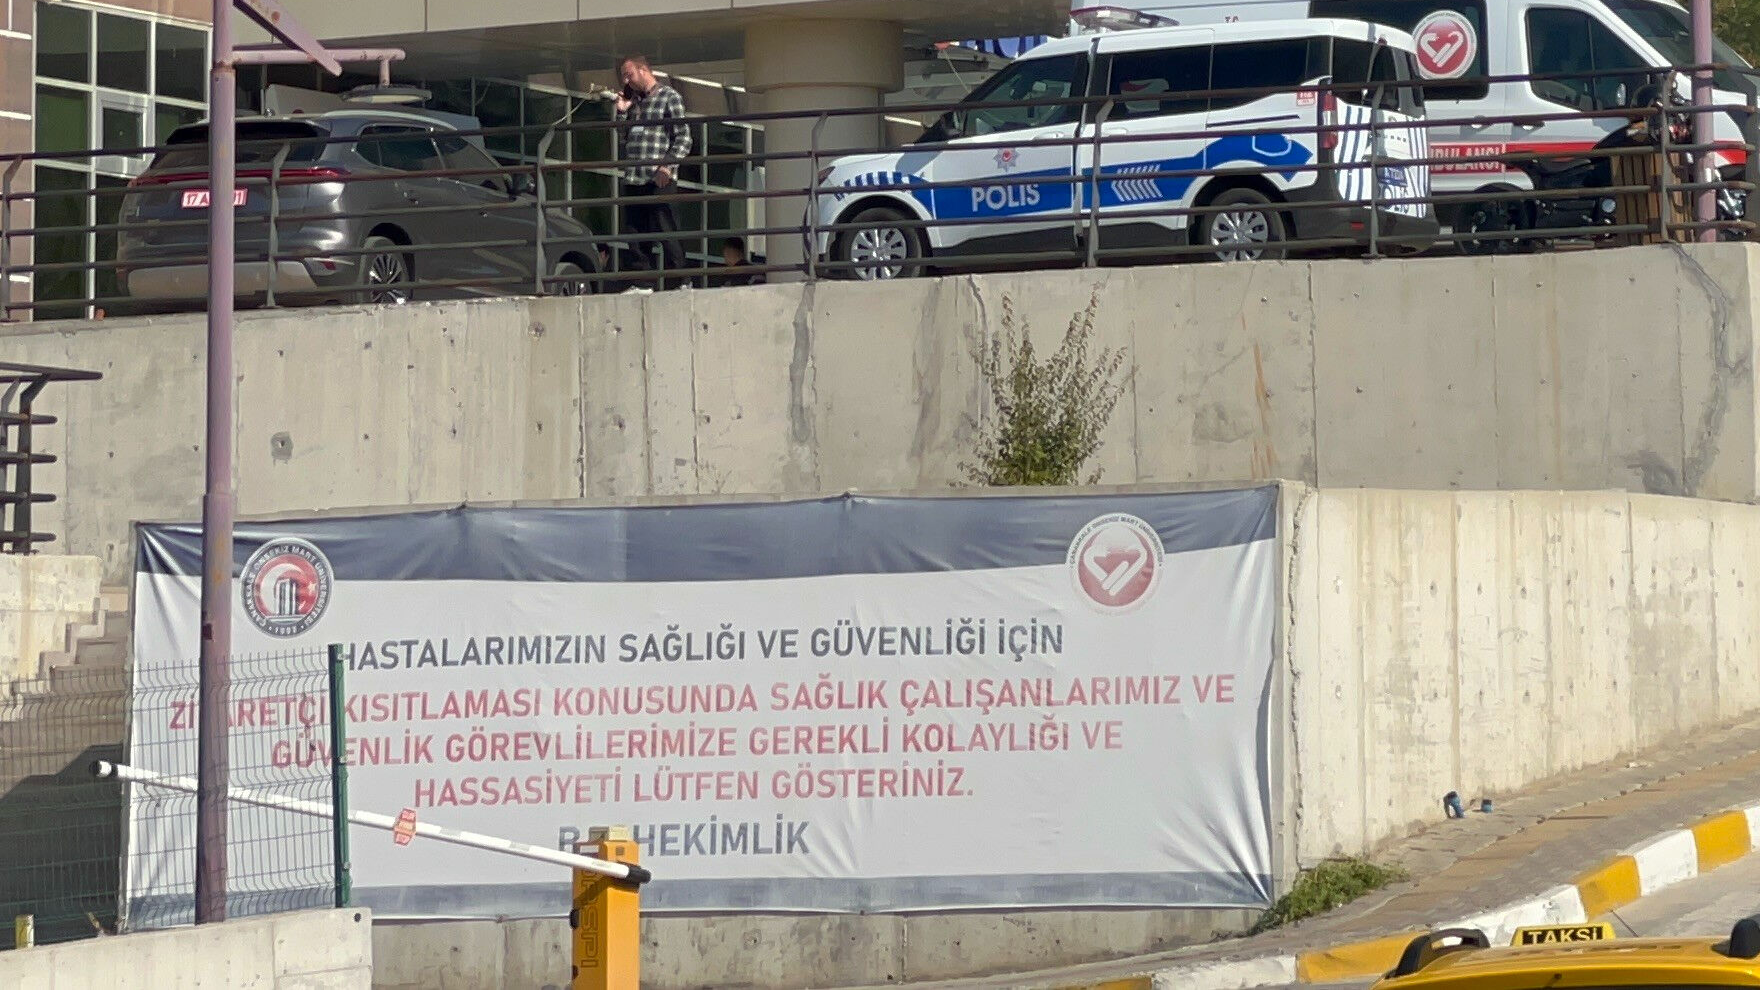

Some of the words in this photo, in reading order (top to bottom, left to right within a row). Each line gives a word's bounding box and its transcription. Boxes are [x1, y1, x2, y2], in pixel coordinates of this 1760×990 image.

[619, 622, 746, 664] SAĞLIĞI
[757, 628, 799, 659] VE
[810, 618, 986, 658] GÜVENLİĞİ
[998, 616, 1064, 662] İÇİN
[343, 687, 541, 723] KISITLAMASI
[553, 682, 758, 716] KONUSUNDA
[770, 671, 888, 711] SAĞLIK
[900, 674, 1181, 716] ÇALIŞANLARIMIZ
[1191, 673, 1236, 704] VE
[445, 718, 737, 765] GÖREVLİLERİMİZE
[748, 715, 889, 756] GEREKLİ
[901, 714, 1069, 754] KOLAYLIĞI
[1081, 720, 1124, 750] VE
[414, 767, 621, 808] HASSASİYETİ
[634, 764, 759, 804] LÜTFEN
[771, 757, 974, 799] GÖSTERİNİZ.
[558, 814, 811, 857] BHEKİMLİK
